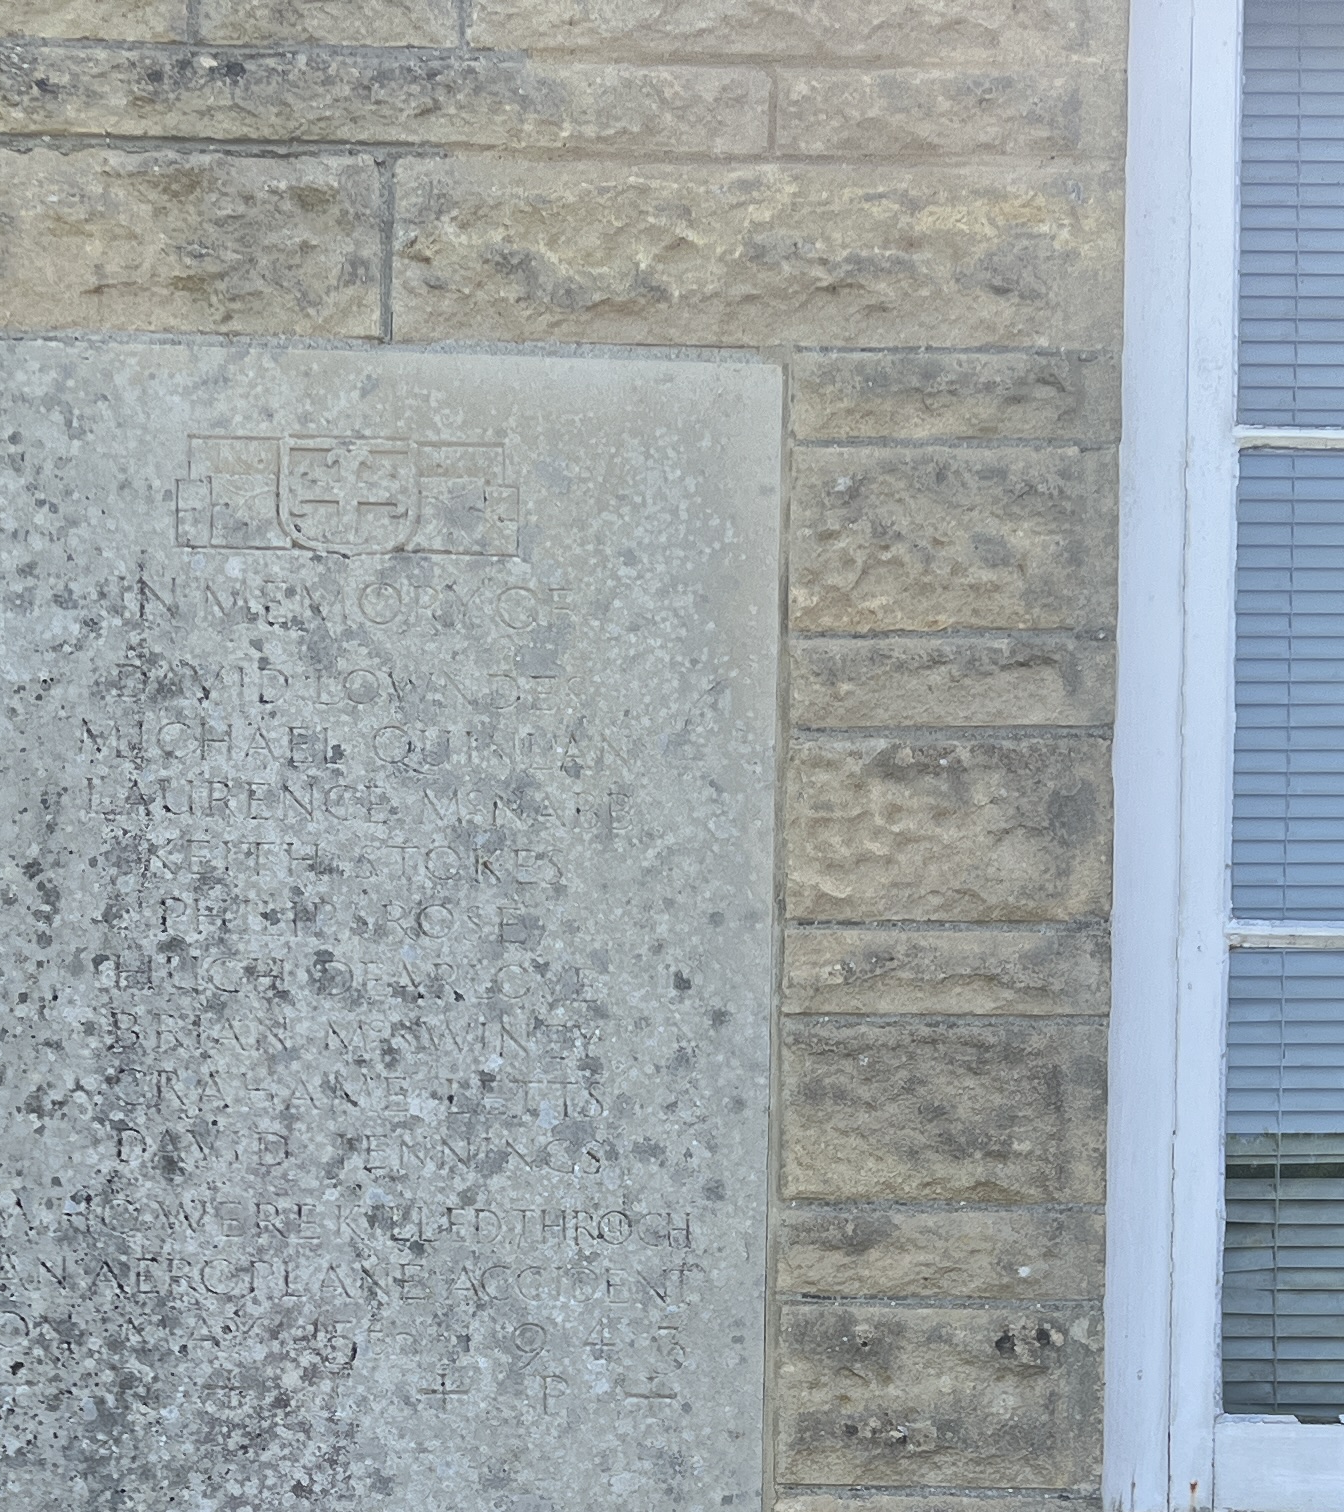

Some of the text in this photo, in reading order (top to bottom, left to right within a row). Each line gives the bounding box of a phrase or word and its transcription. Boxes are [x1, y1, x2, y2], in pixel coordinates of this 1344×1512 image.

[202, 578, 486, 632] MEMORY
[496, 585, 574, 630] OF
[116, 660, 584, 712] DAVID LOWNDES
[80, 718, 634, 776] MICHAEL QUINLAN
[86, 777, 389, 824] LAURENCE
[144, 838, 564, 886] KEITH STOKES
[159, 896, 526, 944] PHILIP ROSE
[109, 1010, 289, 1051] BRIAN
[446, 1077, 605, 1119] LETTS
[116, 1126, 602, 1175] DAVID JENNINGS
[154, 1198, 322, 1240] WERE
[333, 1203, 502, 1246] KILLED
[88, 1255, 436, 1302] AEROPLANE
[446, 1262, 706, 1306] ACCIDENT
